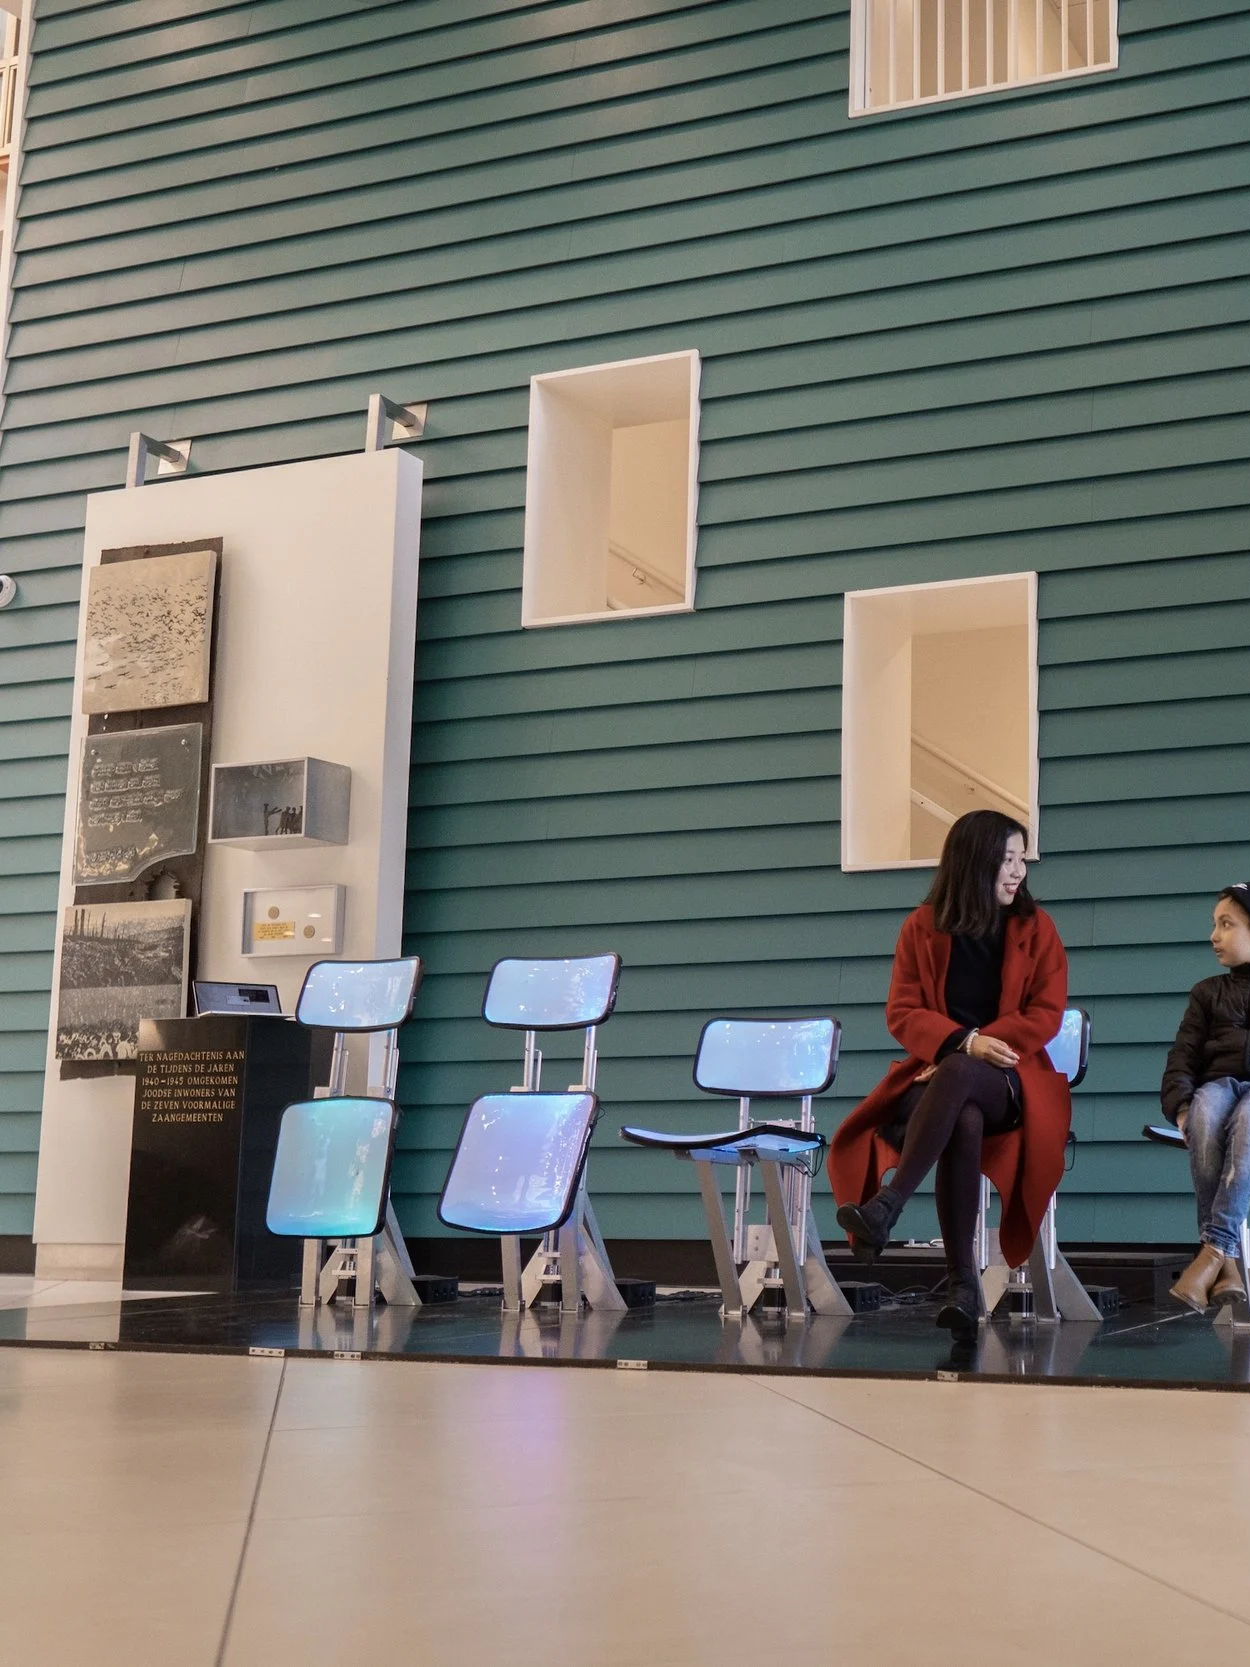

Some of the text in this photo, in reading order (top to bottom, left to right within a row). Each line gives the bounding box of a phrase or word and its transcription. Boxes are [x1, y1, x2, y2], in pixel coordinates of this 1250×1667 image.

[140, 1051, 245, 1062] TER NAGEDACHTENIS AAN
[147, 1064, 234, 1073] DE TIJDENS DE JAREN
[187, 1076, 238, 1085] OMGEKOMEN
[142, 1089, 236, 1097] JOODSE INWONERS VAN
[141, 1101, 235, 1110] DE ZEVEN VOORMALIGE
[152, 1114, 223, 1122] ZAANGEMEENTEN
